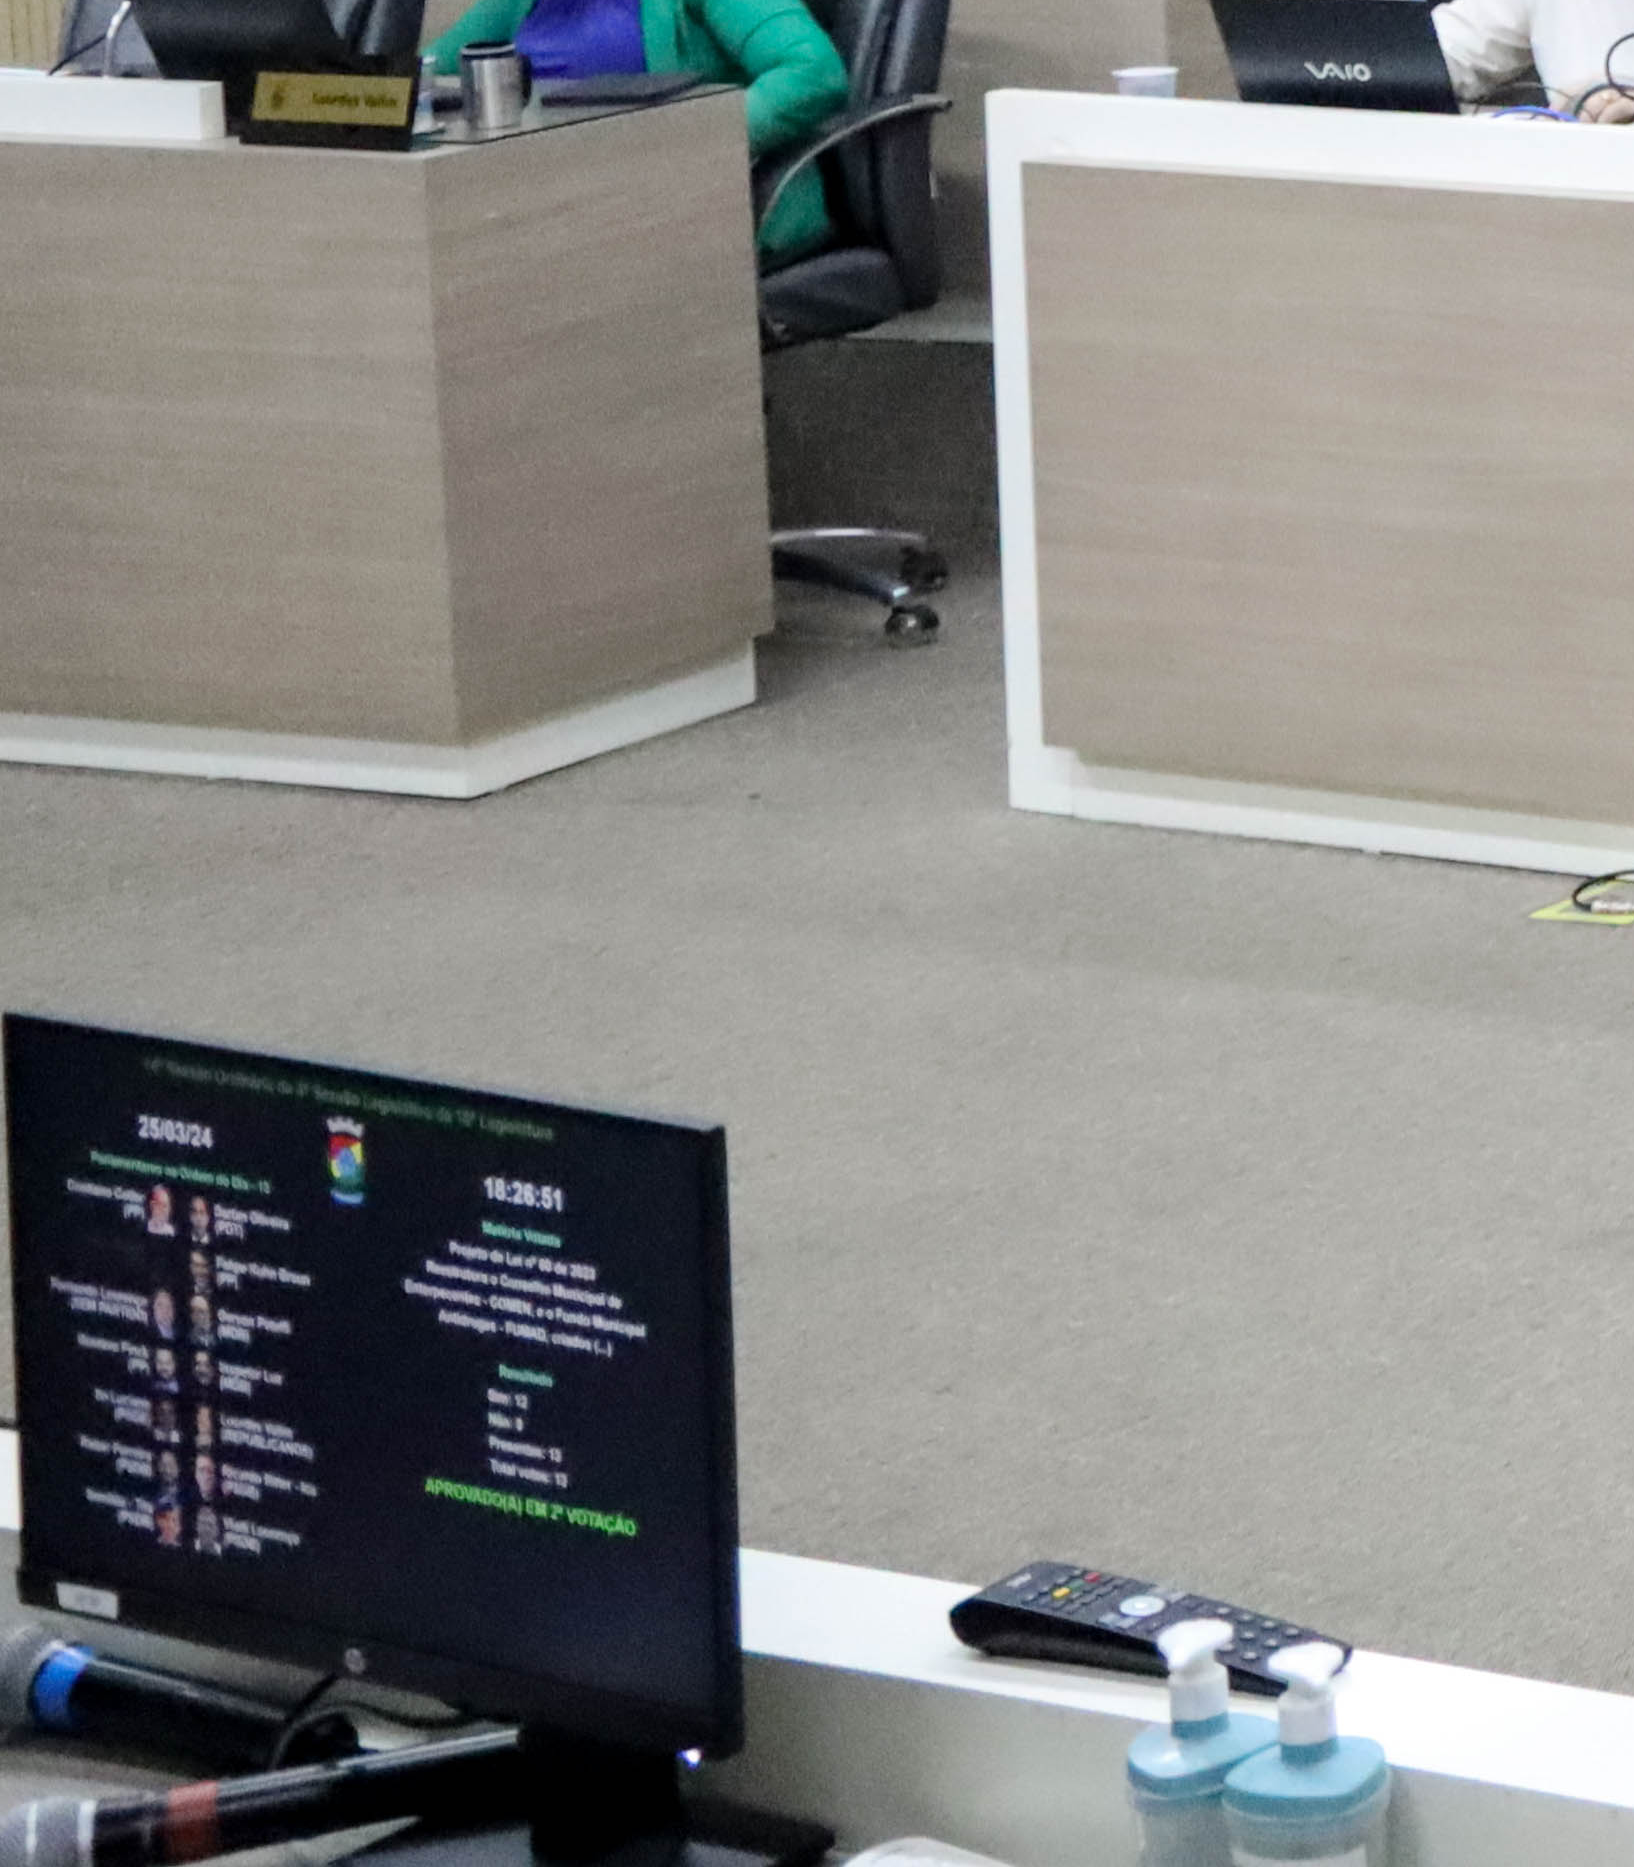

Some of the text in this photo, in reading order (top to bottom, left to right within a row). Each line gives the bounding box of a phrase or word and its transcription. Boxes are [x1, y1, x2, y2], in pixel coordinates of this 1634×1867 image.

[1304, 61, 1371, 82] VAIO
[138, 1115, 214, 1149] 25/03/24
[483, 1176, 563, 1212] 18:26:51
